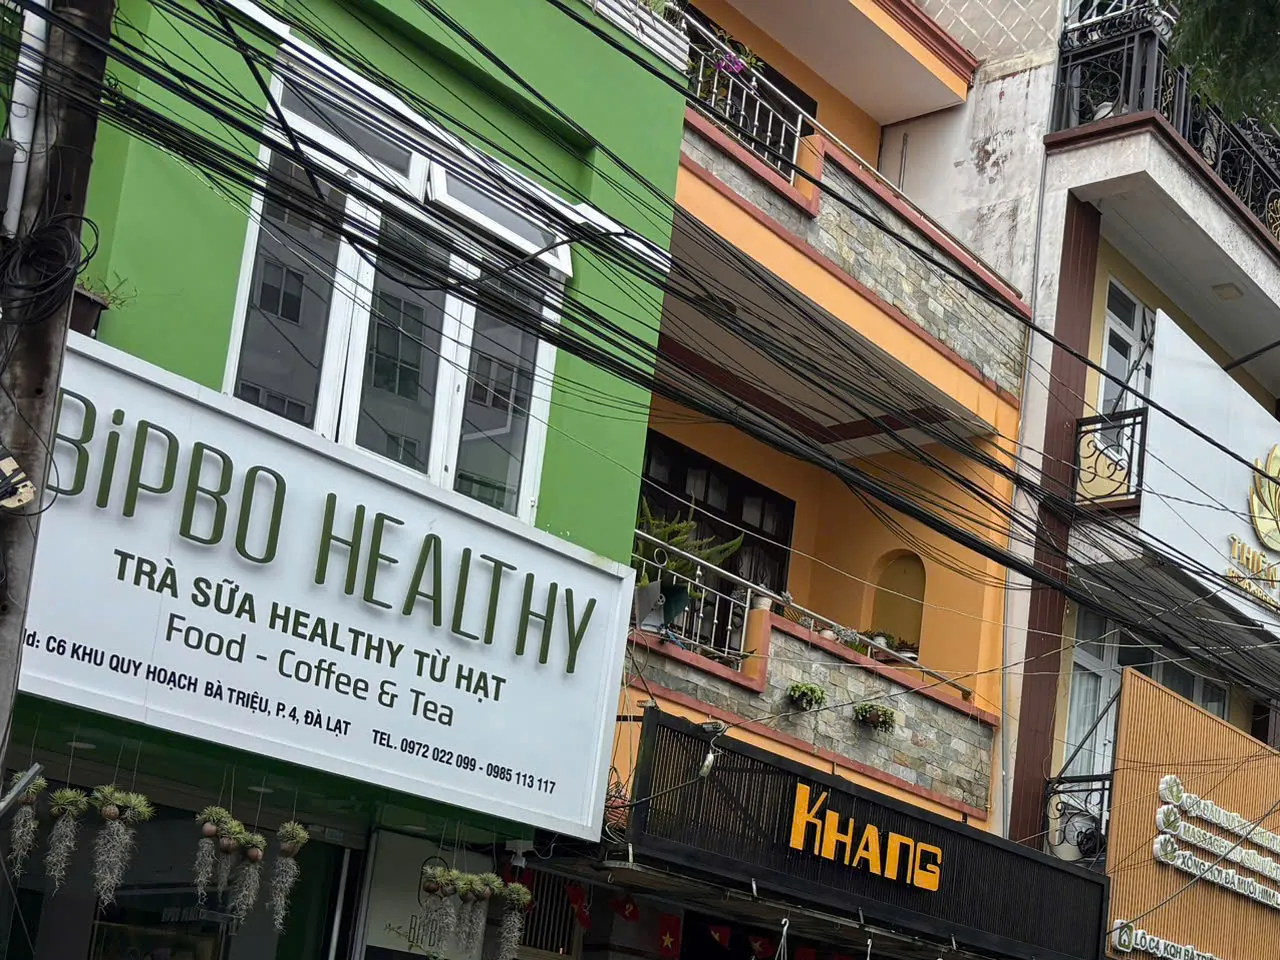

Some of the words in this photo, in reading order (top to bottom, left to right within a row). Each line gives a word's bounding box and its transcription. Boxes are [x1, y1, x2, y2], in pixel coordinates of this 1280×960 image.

[114, 549, 178, 598] TRÀ
[191, 577, 256, 623] SỮA
[269, 602, 404, 668] HEALTHY
[414, 649, 450, 682] TỪ
[455, 664, 506, 702] HẠT
[314, 492, 597, 673] HEALTHY
[46, 636, 67, 655] C6
[71, 642, 104, 666] KHU
[109, 654, 142, 677] QUY
[146, 665, 198, 692] HOẠCH
[204, 680, 223, 700] BÀ
[228, 688, 271, 716] TRIỆU,
[304, 709, 322, 729] ĐÀ
[326, 716, 351, 737] LẠT
[166, 613, 246, 663] Food
[279, 649, 369, 700] Coffee
[378, 680, 398, 708] &
[410, 689, 454, 726] Tea
[373, 729, 397, 750] TEL.
[400, 738, 429, 758] 0972
[432, 747, 453, 765] 022
[456, 754, 476, 772] 099
[486, 763, 512, 782] 0985
[515, 772, 533, 788] 113
[537, 778, 556, 794] 117
